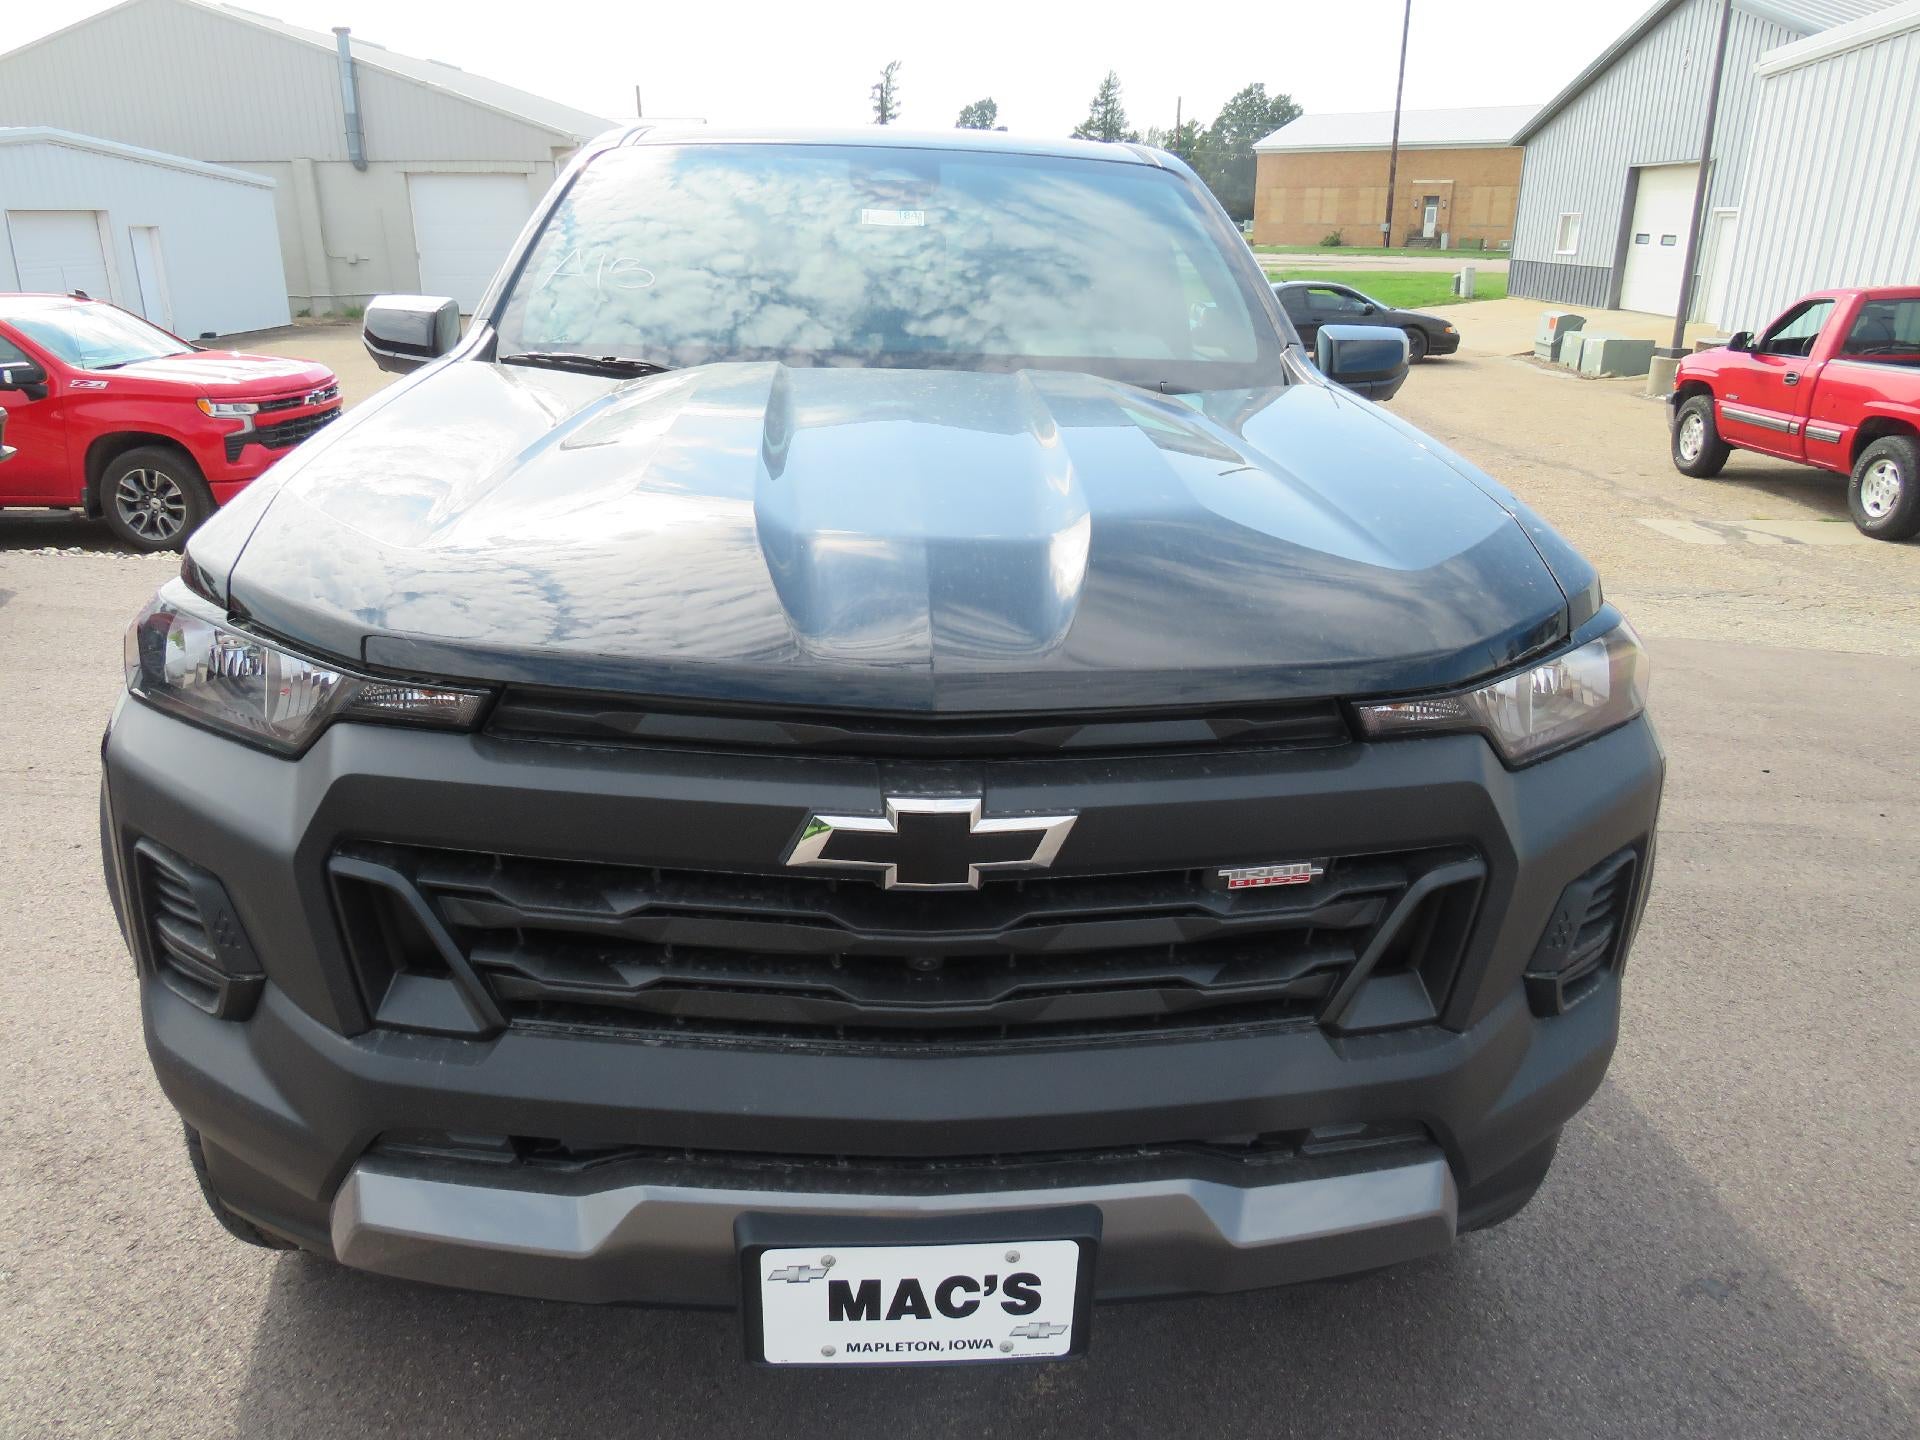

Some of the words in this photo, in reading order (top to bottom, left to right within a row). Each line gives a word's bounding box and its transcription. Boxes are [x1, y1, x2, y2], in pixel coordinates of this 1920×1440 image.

[1228, 874, 1310, 889] BOSS
[828, 1272, 1042, 1322] MAC'S
[846, 1340, 944, 1354] MAPLETON,
[949, 1338, 994, 1351] IOWA
